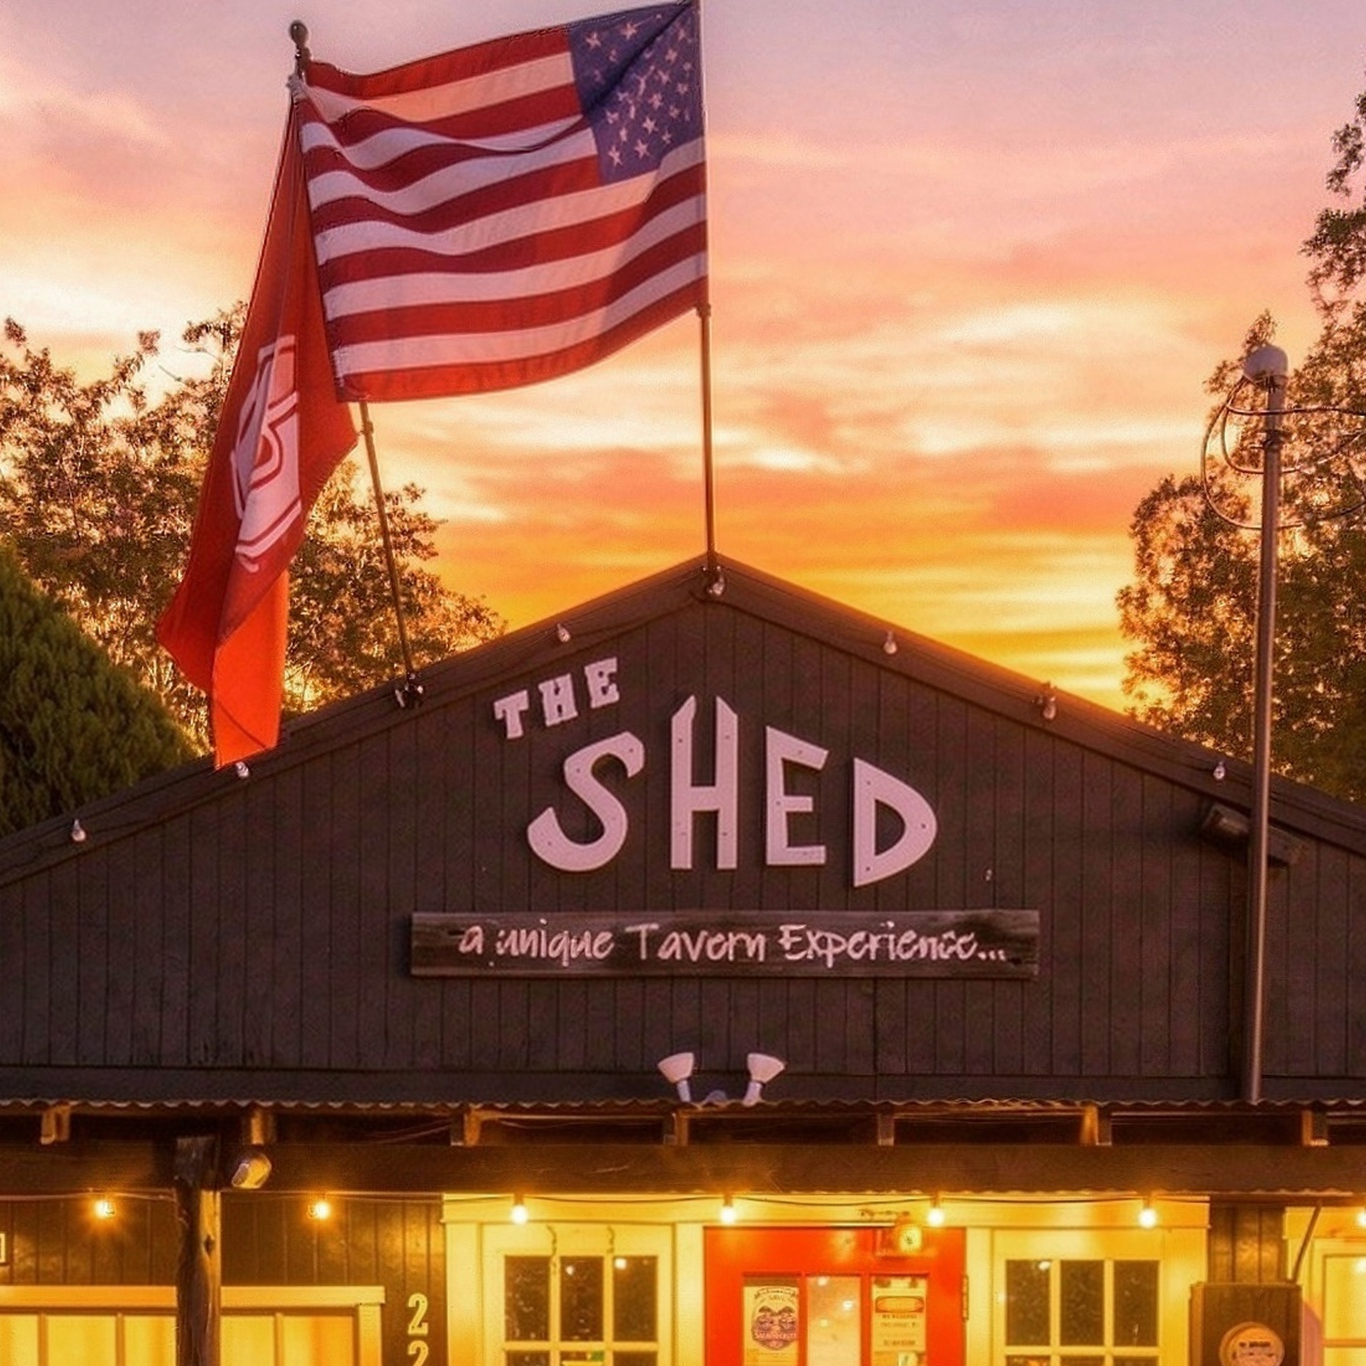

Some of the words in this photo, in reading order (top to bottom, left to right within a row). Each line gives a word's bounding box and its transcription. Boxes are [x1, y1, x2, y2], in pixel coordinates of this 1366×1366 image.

[494, 657, 620, 738] THE
[527, 696, 937, 887] SHED
[496, 919, 615, 967] unique
[625, 922, 766, 962] Tavern
